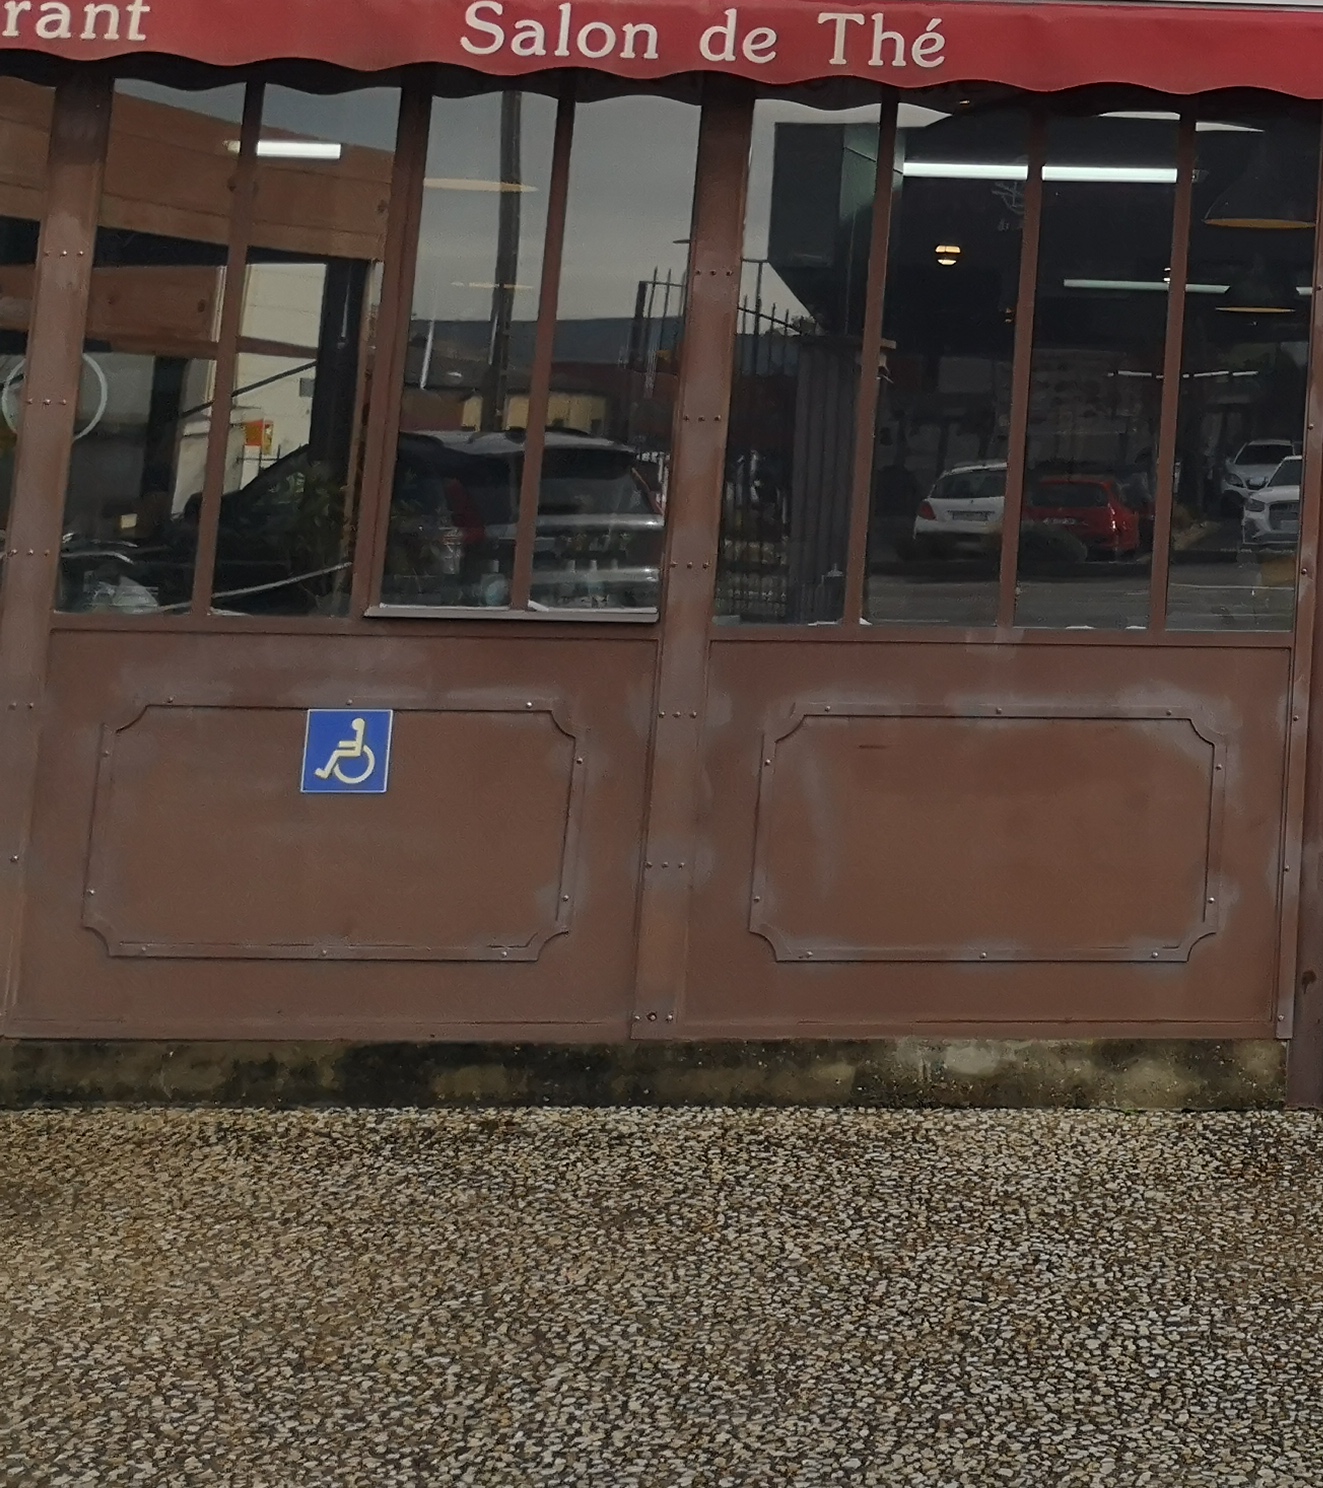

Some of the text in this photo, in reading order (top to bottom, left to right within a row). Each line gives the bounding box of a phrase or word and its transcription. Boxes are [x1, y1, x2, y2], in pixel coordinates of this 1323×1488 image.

[459, 0, 659, 61] Salon
[699, 7, 778, 65] de
[817, 5, 946, 69] Thé
